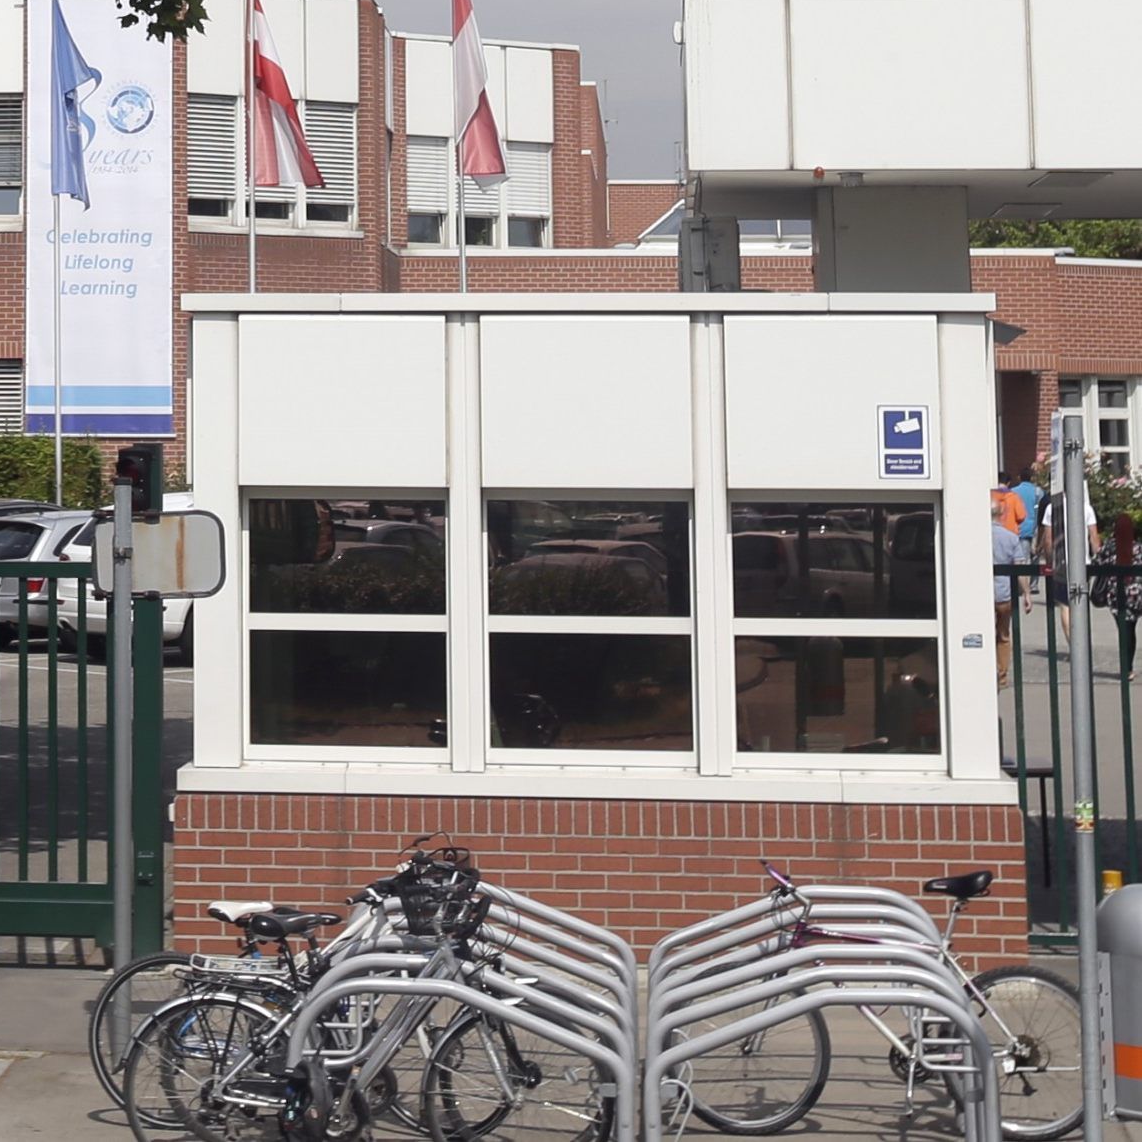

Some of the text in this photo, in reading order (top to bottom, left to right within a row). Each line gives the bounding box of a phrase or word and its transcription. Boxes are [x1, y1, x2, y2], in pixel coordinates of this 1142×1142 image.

[88, 148, 154, 167] years
[46, 229, 153, 247] Celebrating
[64, 254, 134, 273] Lifelong
[60, 280, 138, 299] Learning
